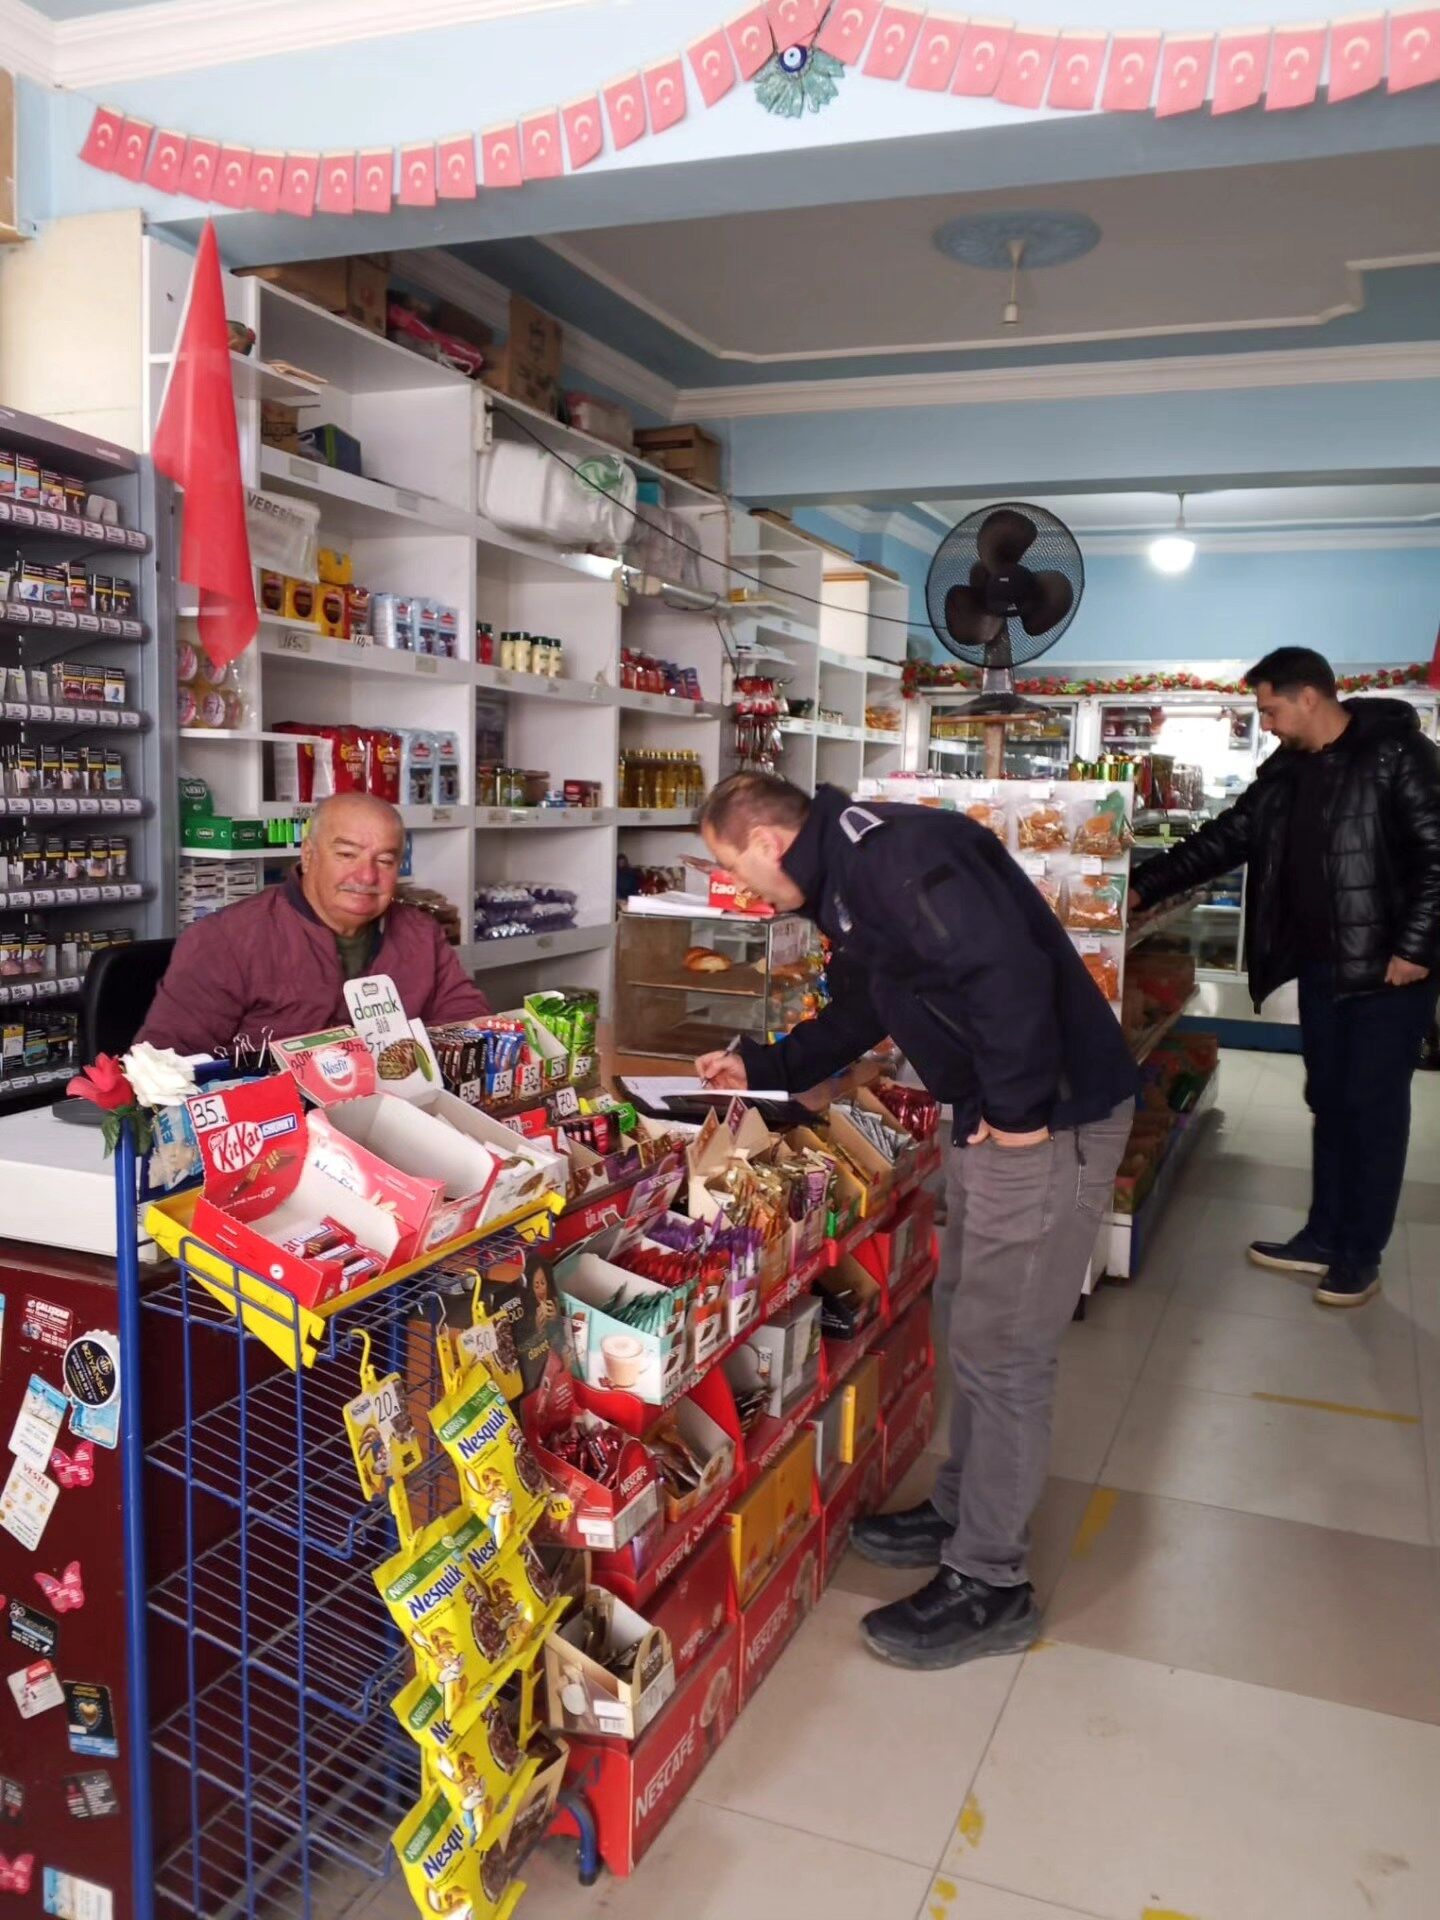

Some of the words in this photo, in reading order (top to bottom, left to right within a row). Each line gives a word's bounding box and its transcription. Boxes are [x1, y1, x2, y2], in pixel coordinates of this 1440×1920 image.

[354, 986, 400, 1020] damak
[321, 1059, 348, 1077] Nesfit
[193, 1099, 219, 1129] 35
[218, 1123, 261, 1171] KitKat
[375, 1391, 392, 1421] 20
[457, 1407, 509, 1460] Nesquik
[406, 1563, 466, 1620] Nesquik
[635, 1714, 697, 1827] NESCAFÉ
[422, 1823, 465, 1879] Nesqu
